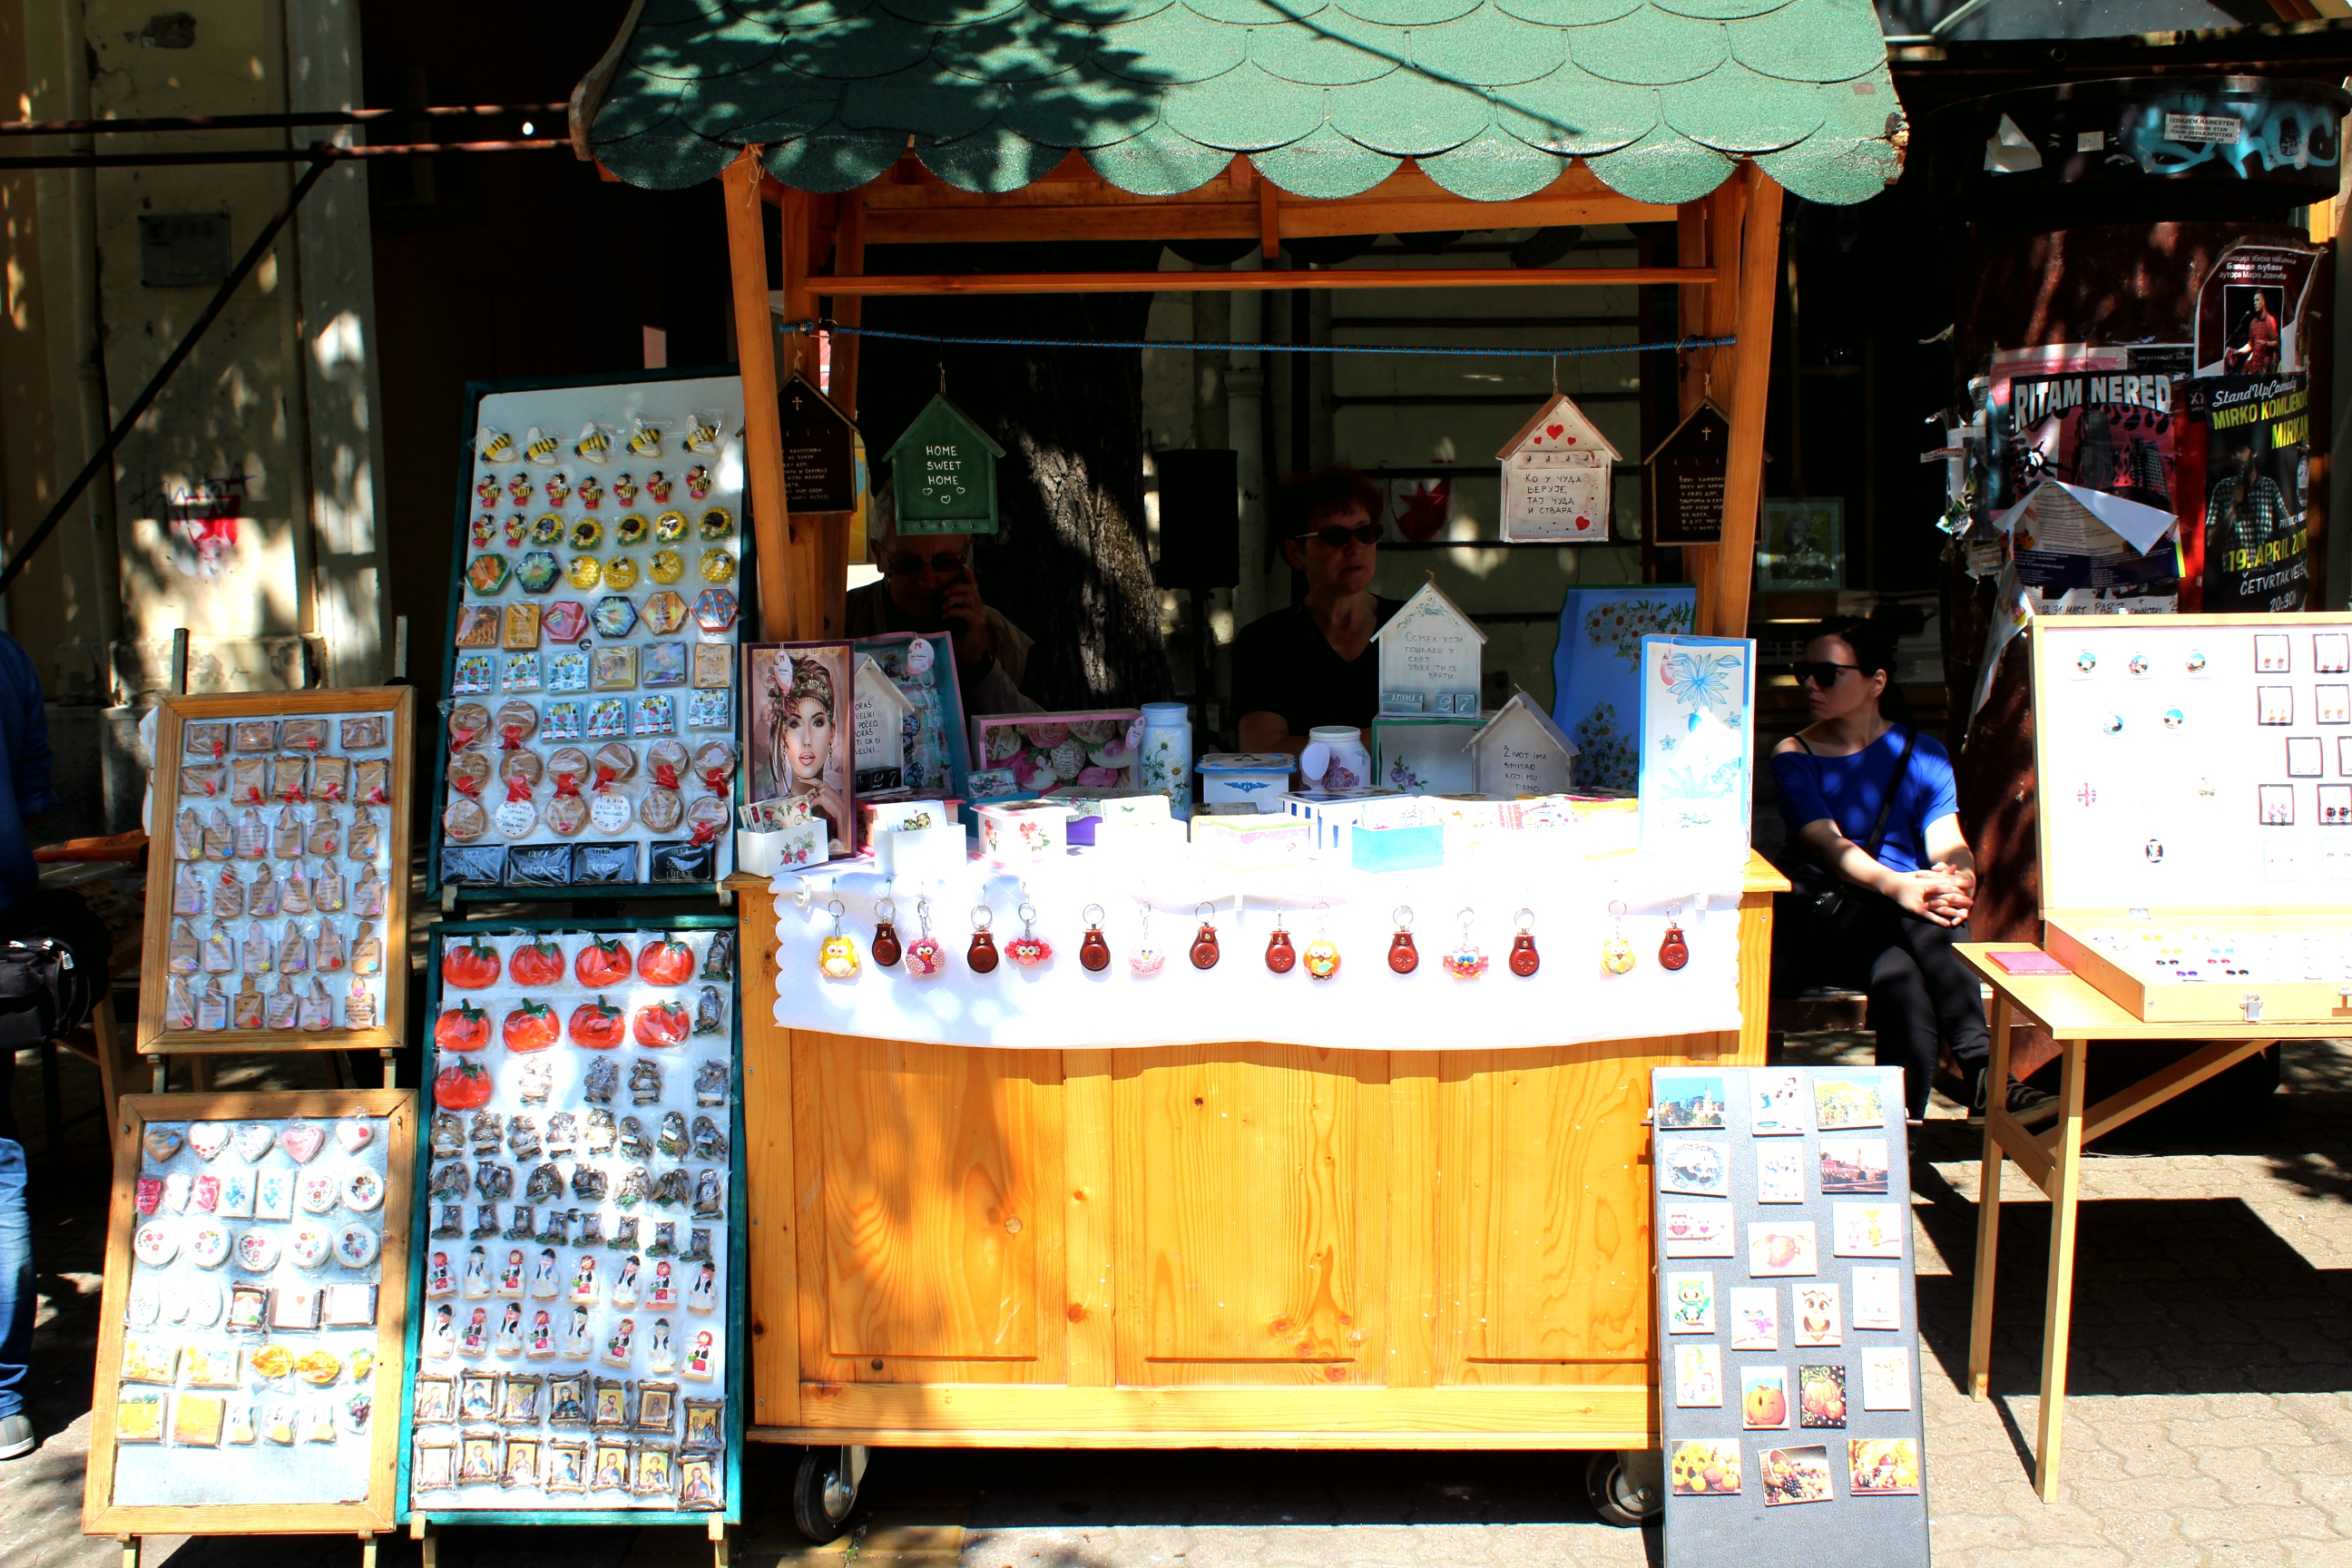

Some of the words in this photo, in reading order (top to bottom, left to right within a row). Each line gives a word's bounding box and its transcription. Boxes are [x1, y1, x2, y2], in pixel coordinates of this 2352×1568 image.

[2014, 377, 2082, 434] RITAM
[2090, 374, 2171, 415] NERED
[2212, 404, 2258, 430] MIRKO
[926, 446, 957, 456] HOME
[926, 461, 962, 471] SWEET
[927, 475, 959, 485] HOME
[1556, 475, 1582, 484] ЧУДА
[1527, 496, 1544, 505] ТАЈ
[1551, 496, 1574, 505] ЧУДА
[2229, 548, 2252, 573] 19.
[2254, 537, 2290, 568] APRIL
[2239, 572, 2289, 596] ČETVRTAK
[2064, 604, 2087, 615] MART
[1405, 631, 1437, 642] ОСМЕХ
[855, 700, 872, 710] ORAŠ
[855, 729, 873, 738] ORAŠ
[1503, 745, 1529, 759] ŽIVOT
[1504, 762, 1535, 770] SMISAO
[1504, 772, 1523, 780] KOJI
